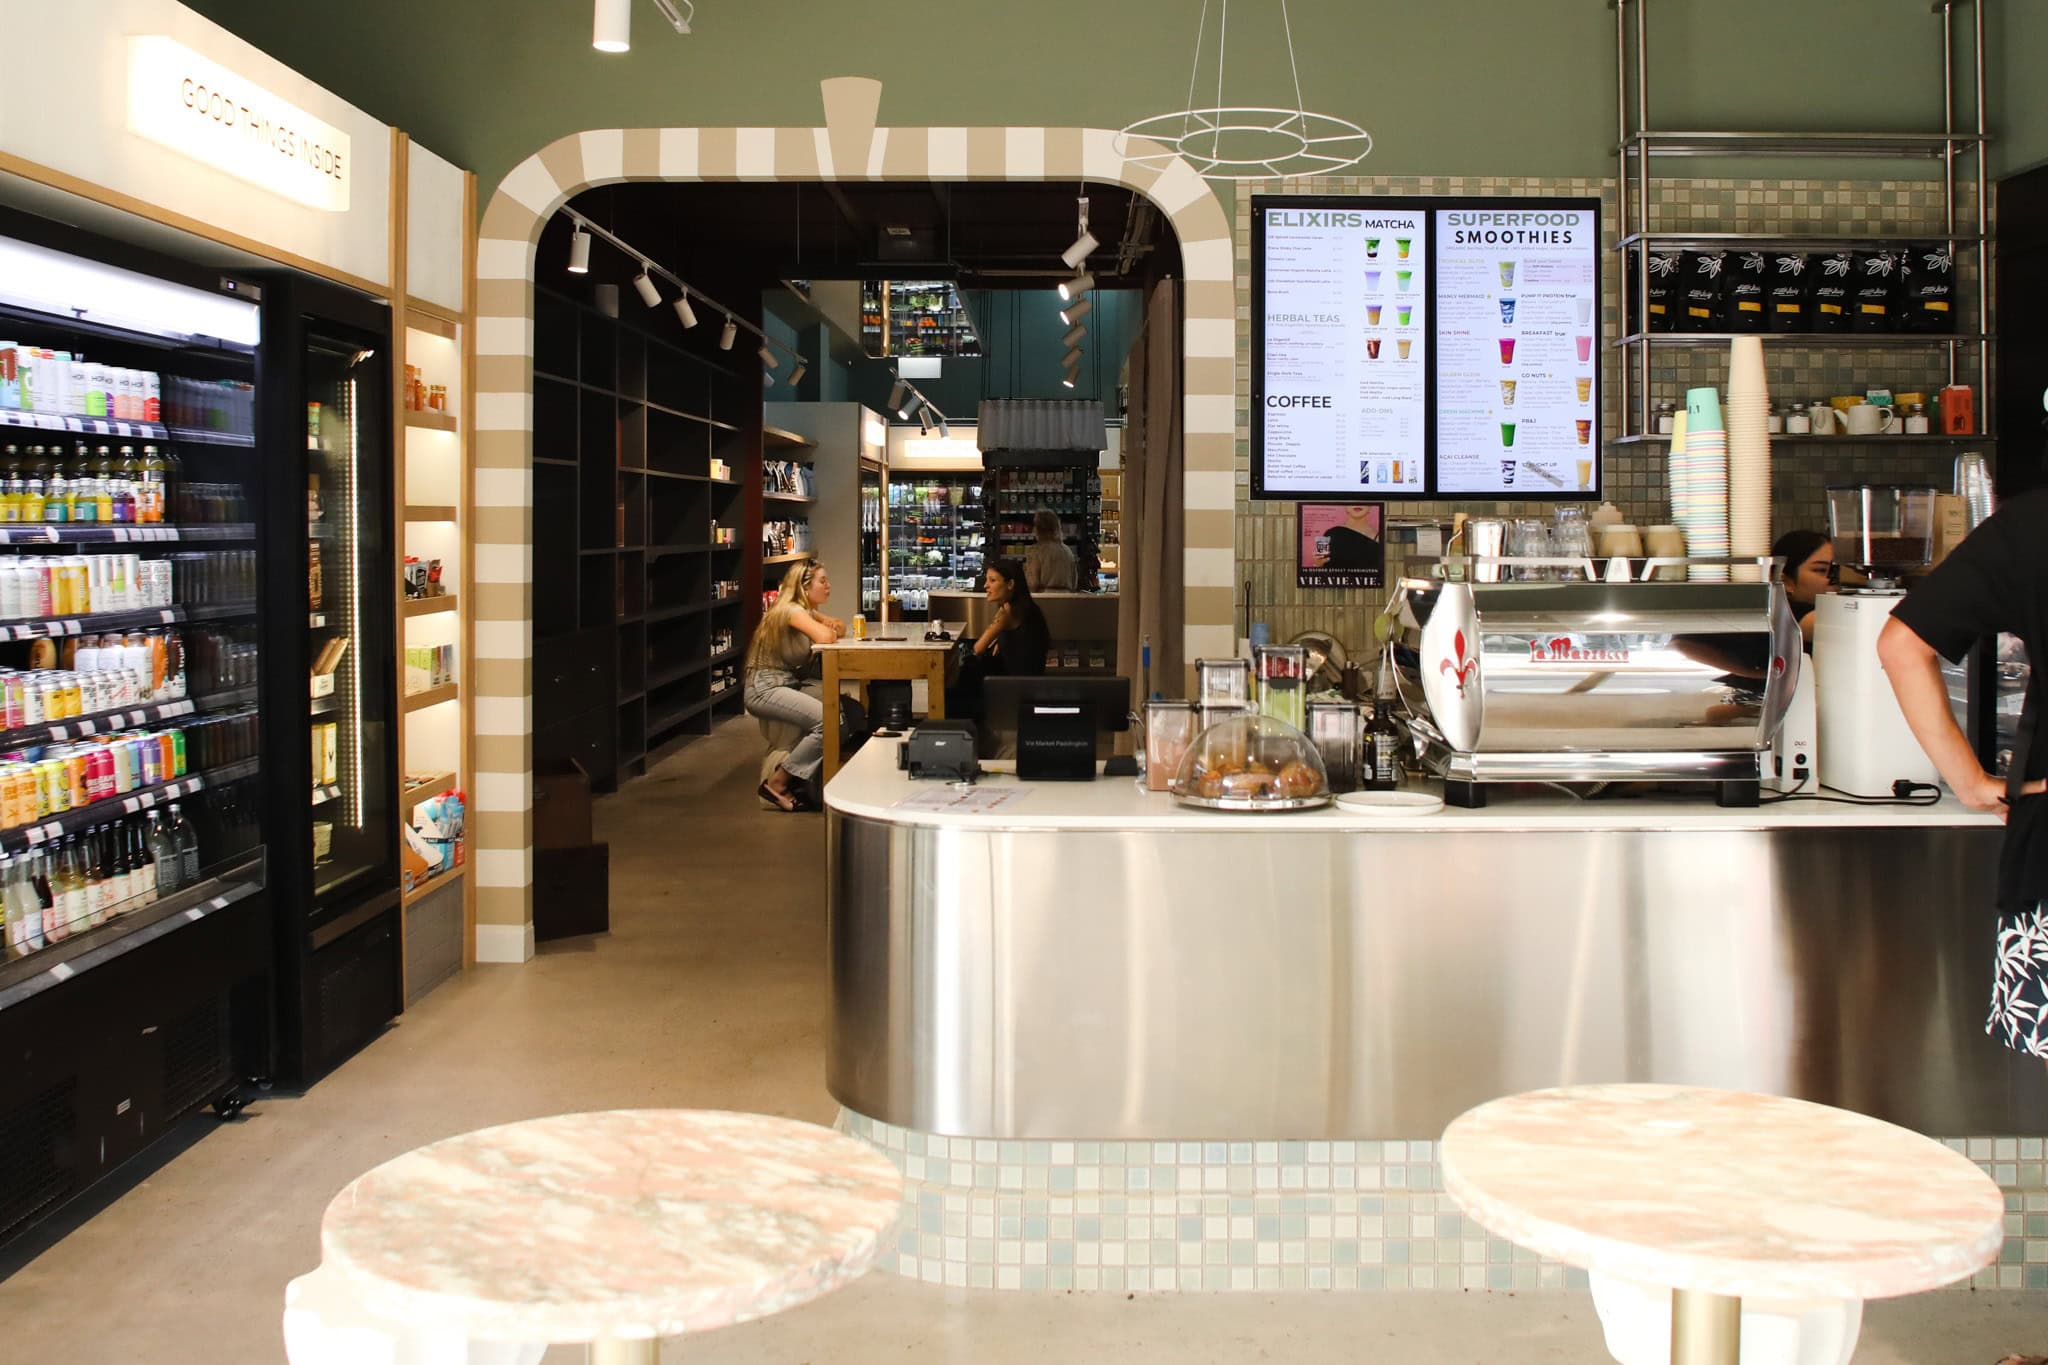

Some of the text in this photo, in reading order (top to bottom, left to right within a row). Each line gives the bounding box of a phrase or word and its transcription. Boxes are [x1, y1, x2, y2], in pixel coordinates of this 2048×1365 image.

[182, 78, 341, 180] GOOD THINGS INSIDE
[1268, 212, 1362, 227] ELIXIRS
[1365, 219, 1415, 229] MATCHA
[1448, 213, 1580, 227] SUPERFOOD
[1455, 230, 1573, 244] SMOOTHIES
[1267, 314, 1340, 323] HERBAL TEAS
[1266, 395, 1332, 408] COFFEE
